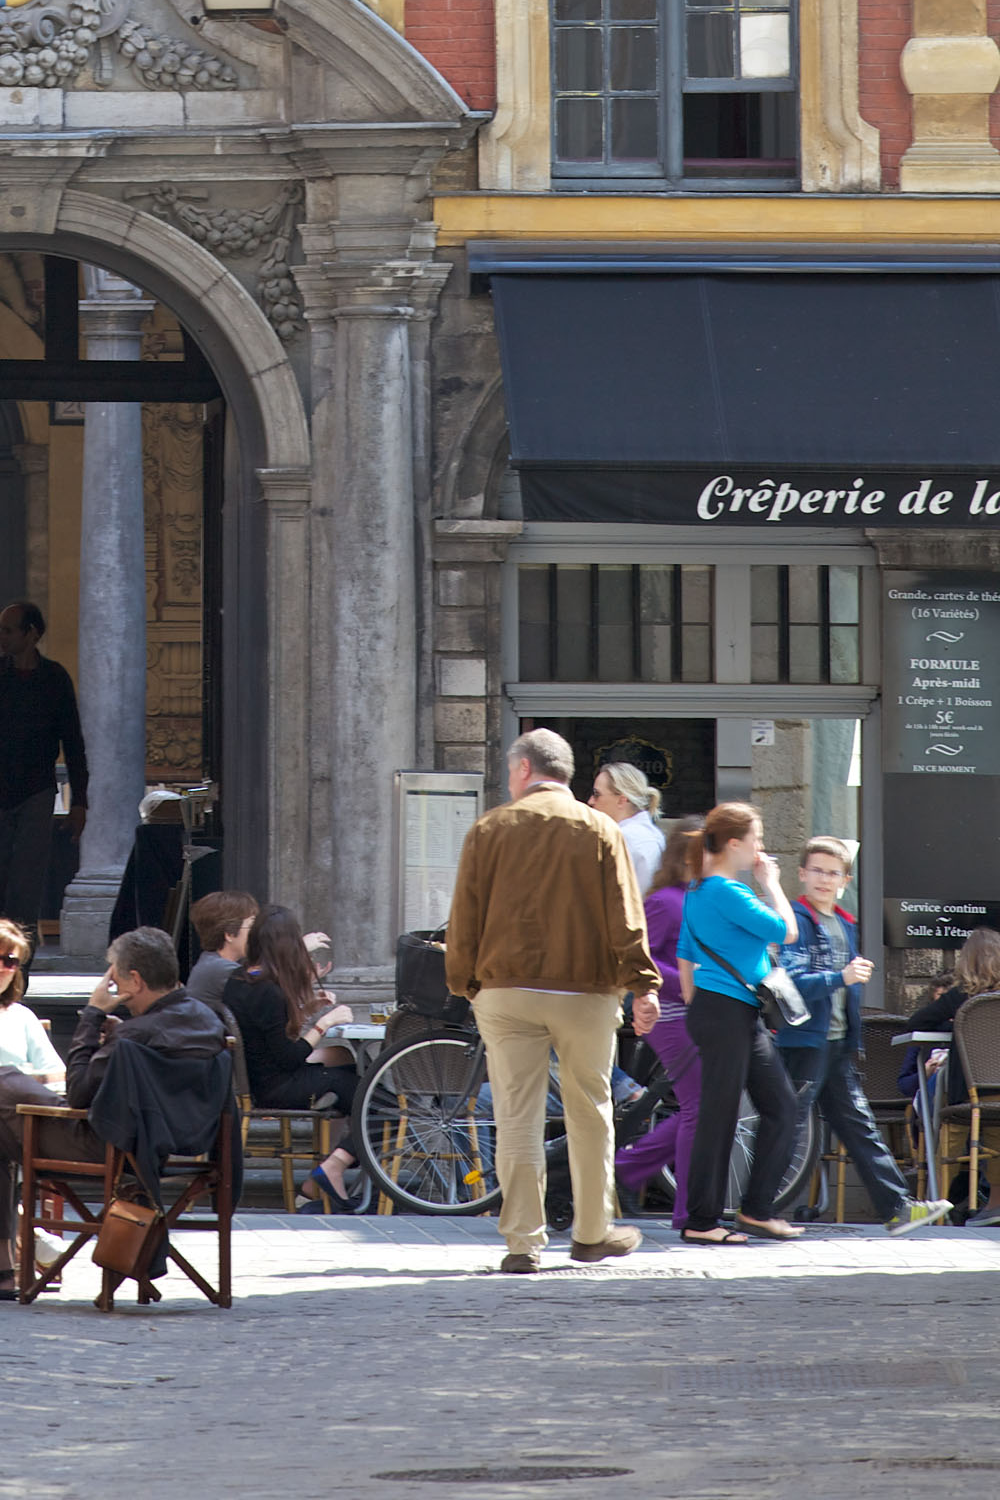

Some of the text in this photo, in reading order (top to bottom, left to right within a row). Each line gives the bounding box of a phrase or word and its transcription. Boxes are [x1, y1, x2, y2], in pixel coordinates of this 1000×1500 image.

[697, 475, 886, 521] Crêperie
[898, 479, 954, 515] de
[934, 592, 965, 601] cartes
[966, 591, 980, 601] de
[911, 607, 980, 621] (16 Variétés)
[910, 658, 981, 671] FORMULE
[912, 677, 981, 690] Après-midi
[897, 696, 904, 705] 1
[905, 696, 935, 708] Crêpe
[946, 697, 953, 706] 1
[954, 697, 992, 707] Boisson
[935, 710, 955, 724] 5€
[900, 901, 987, 914] Service continu
[906, 925, 933, 936] Salle
[935, 926, 942, 936] à
